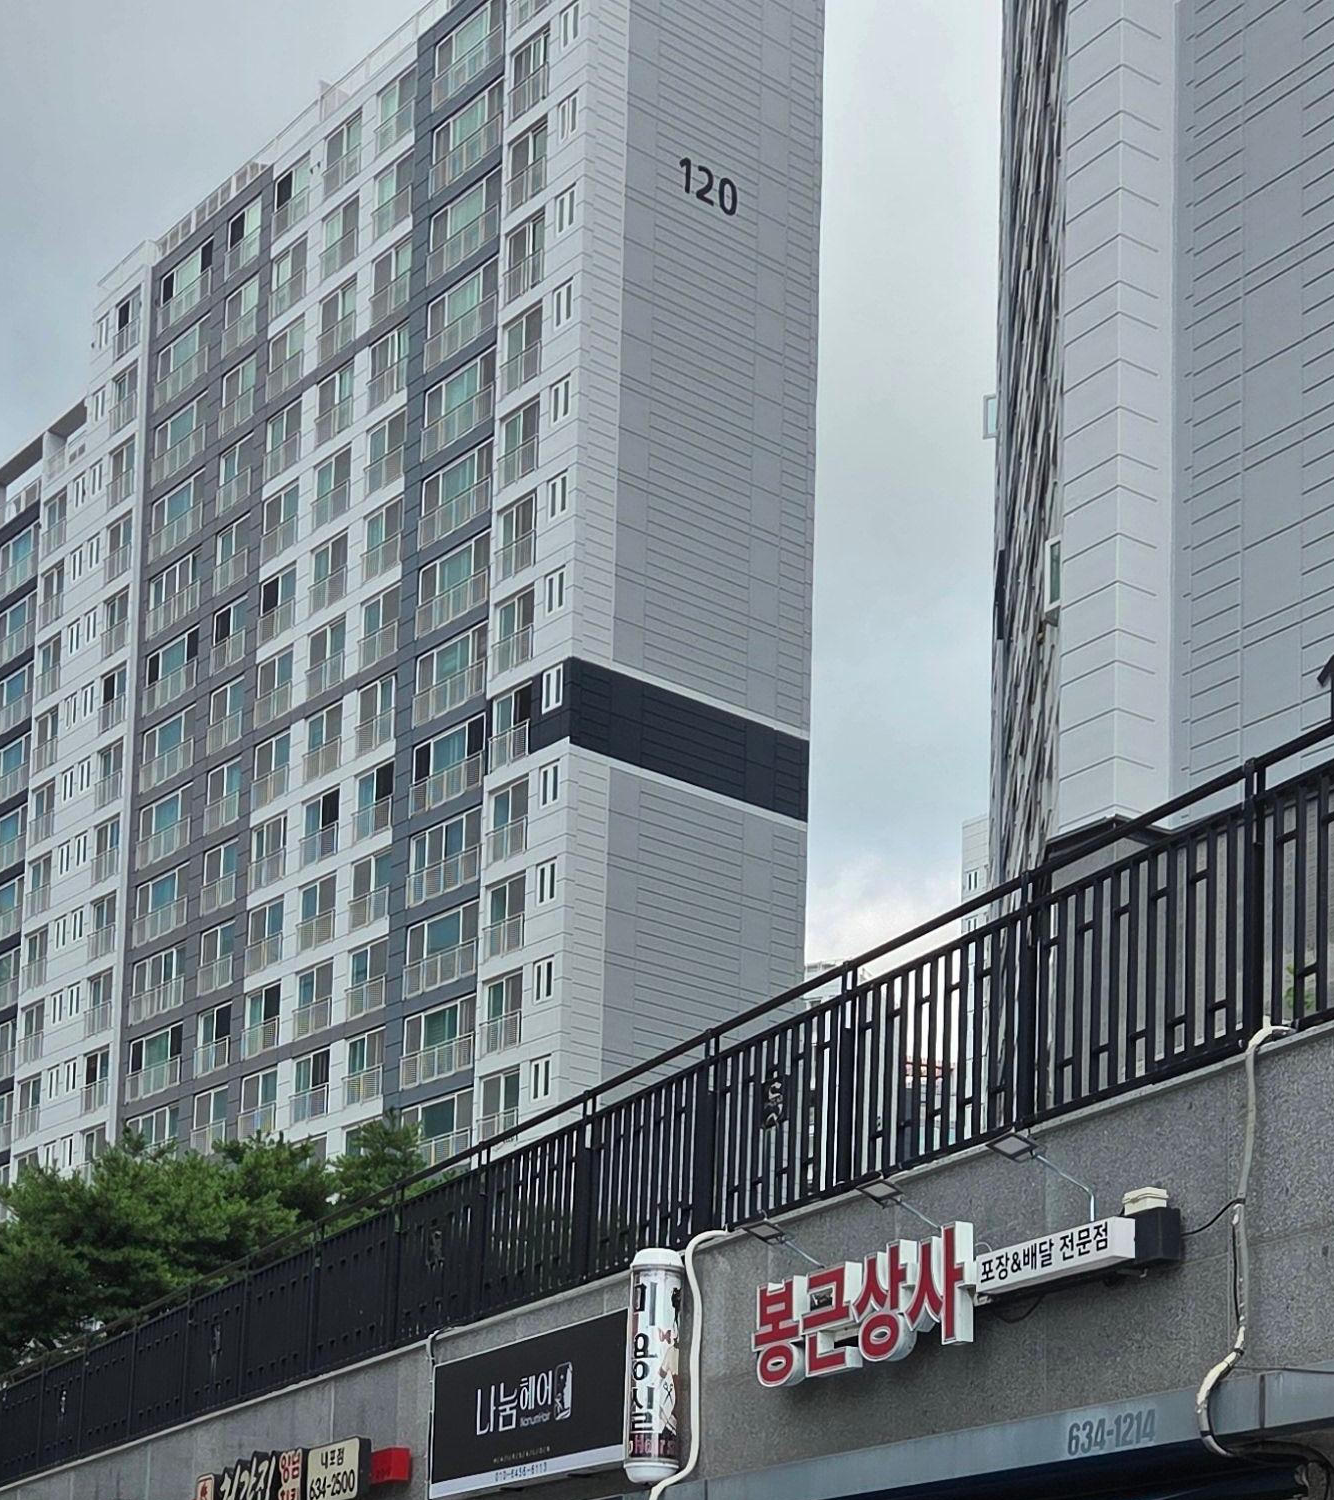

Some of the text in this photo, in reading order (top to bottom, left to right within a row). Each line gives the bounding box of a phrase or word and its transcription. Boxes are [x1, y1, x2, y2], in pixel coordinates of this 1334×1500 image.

[679, 157, 738, 216] 120
[752, 1220, 1109, 1388] 봉근상사 포장&배달 전문점
[476, 1369, 553, 1436] 나눔헤어
[320, 1446, 346, 1470] 내포점
[1068, 1408, 1157, 1455] 634-1214
[279, 1450, 302, 1484] 양념
